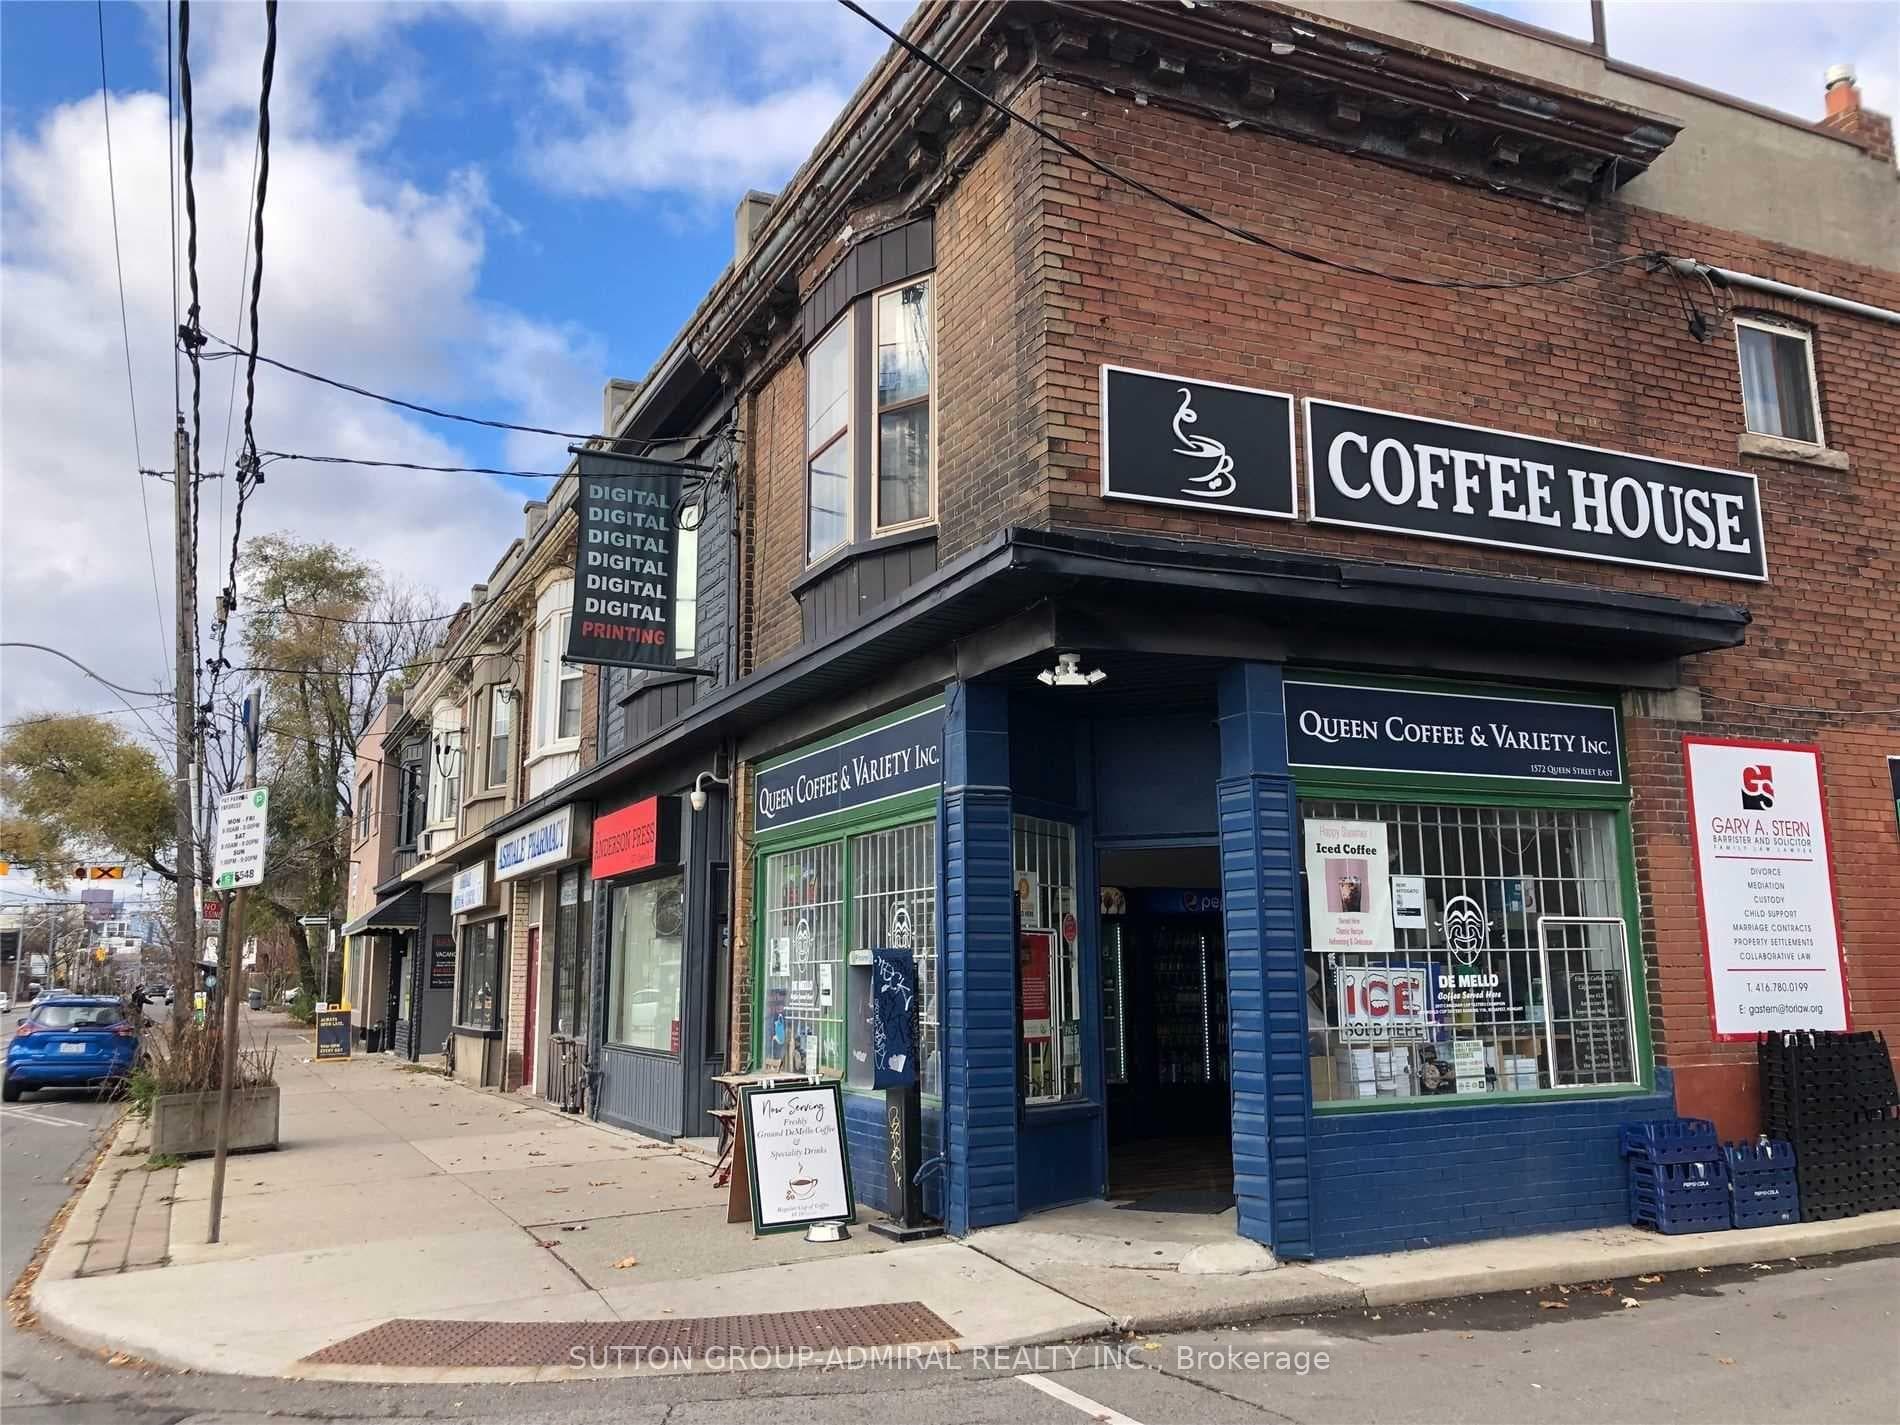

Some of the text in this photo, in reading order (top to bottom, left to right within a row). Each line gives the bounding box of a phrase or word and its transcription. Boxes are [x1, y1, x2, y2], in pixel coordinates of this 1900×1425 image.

[589, 484, 670, 509] DIGITAL
[1328, 431, 1750, 554] COFFEE HOUSE
[588, 507, 670, 532] DIGITAL
[588, 529, 669, 554] DIGITAL
[587, 551, 668, 577] DIGITAL
[586, 574, 667, 600] DIGITAL
[585, 597, 666, 622] DIGITAL
[581, 620, 665, 646] PRINTING
[1299, 710, 1611, 755] QUEEN COFFEE & VARIETY INC.
[1530, 764, 1613, 777] 1572 QUEEN STREET EAST
[759, 744, 940, 818] QUEEN COFFEE & VARIETY INC.
[1712, 817, 1810, 837] GARY A. STERN
[528, 817, 567, 859] PHARMACY
[595, 829, 631, 860] ANDERSON
[632, 821, 655, 849] PRESS
[1713, 835, 1812, 847] BARRISTER AND SOLICITOR
[1316, 843, 1377, 855] Iced Coffee
[1750, 867, 1782, 876] DIVORCE
[1747, 881, 1785, 889] MEDIATION
[1753, 895, 1785, 904] CUSTODY
[203, 903, 217, 911] NO
[1744, 910, 1797, 918] CHILD SUPPORT
[1732, 924, 1812, 932] MARRIAGE CONTRACTS
[1733, 938, 1814, 946] PROPERTY SETTLEMENTS
[1739, 952, 1811, 960] COLLABORATIVE LAW
[1438, 974, 1499, 988] DE MELLO
[1755, 982, 1808, 992] 416.780.0199
[1343, 975, 1420, 1018] ICE
[1437, 990, 1501, 1001] Coffee Served Here
[1749, 1003, 1823, 1016] gastern@torlaw.org
[1344, 1022, 1424, 1037] SOLD HERE
[762, 1097, 825, 1122] Now Serving
[783, 1117, 807, 1126] Freshly
[757, 1129, 783, 1138] Ground
[815, 1125, 836, 1135] Coffee
[804, 1147, 827, 1156] Drinks
